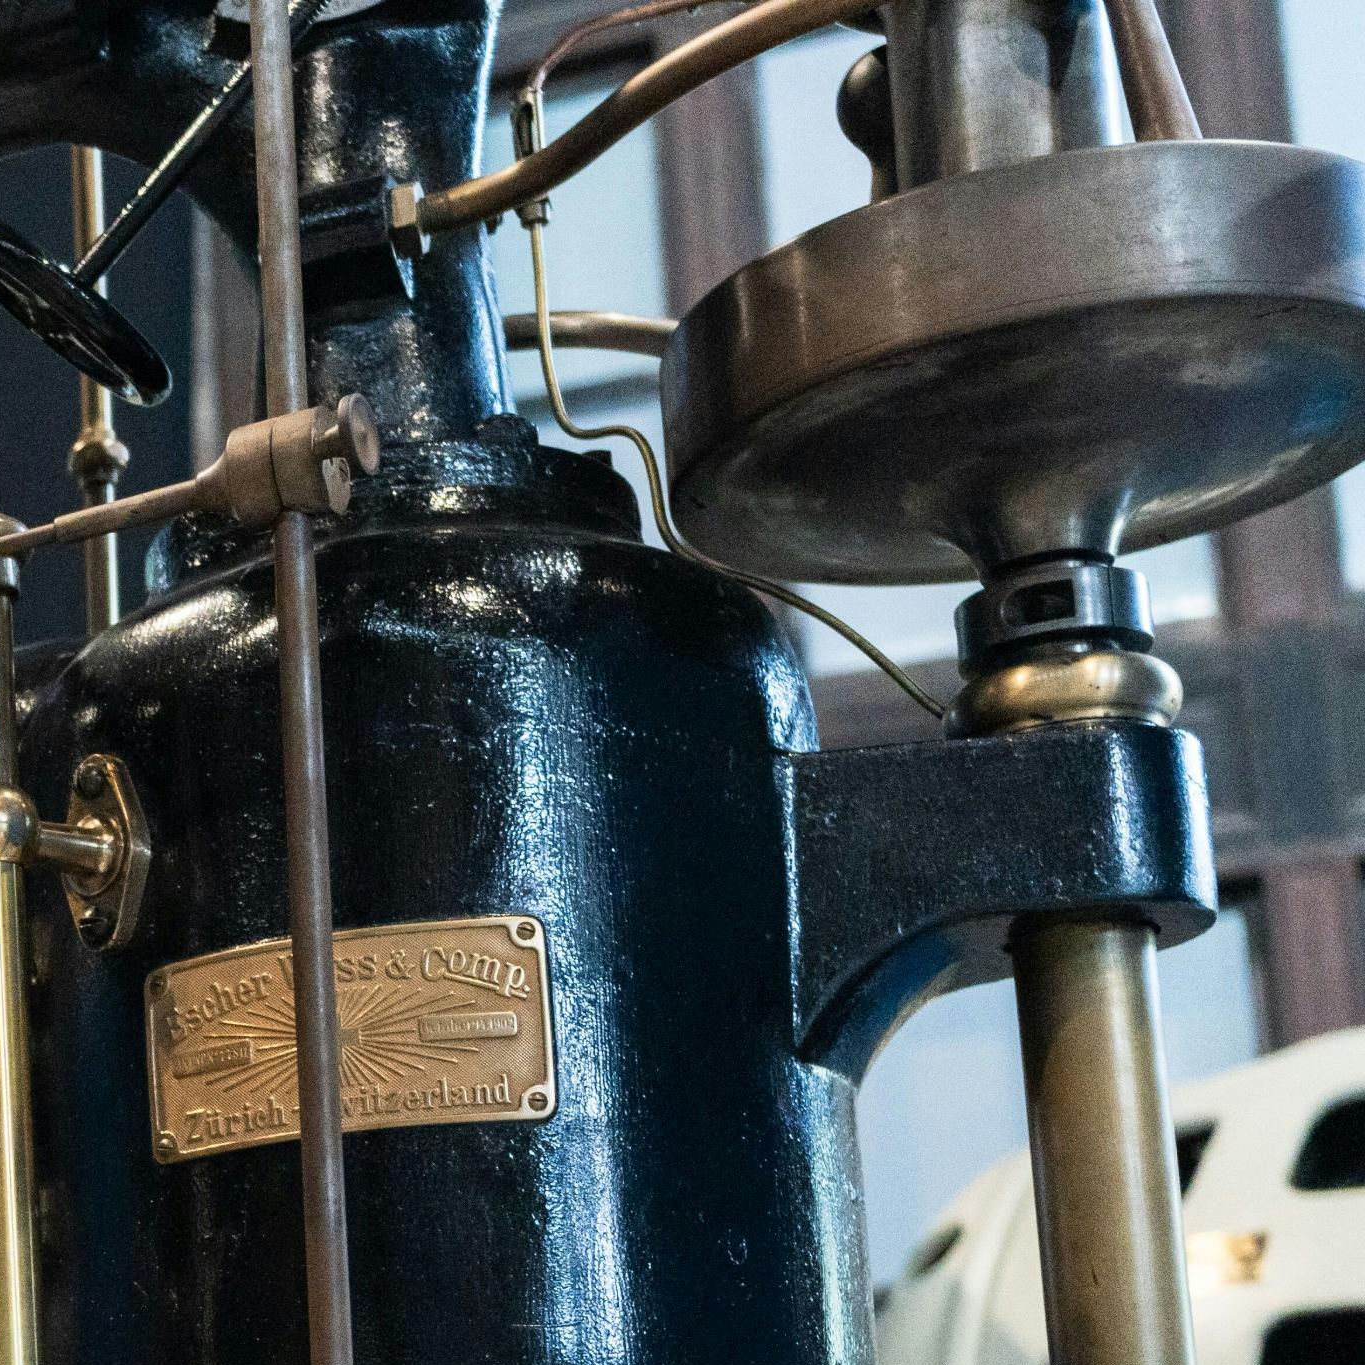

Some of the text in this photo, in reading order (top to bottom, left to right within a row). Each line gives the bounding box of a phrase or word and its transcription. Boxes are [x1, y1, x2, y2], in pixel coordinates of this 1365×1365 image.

[166, 946, 531, 1042] Escher ss & Comp.
[184, 1073, 512, 1144] Zürich itzerland
